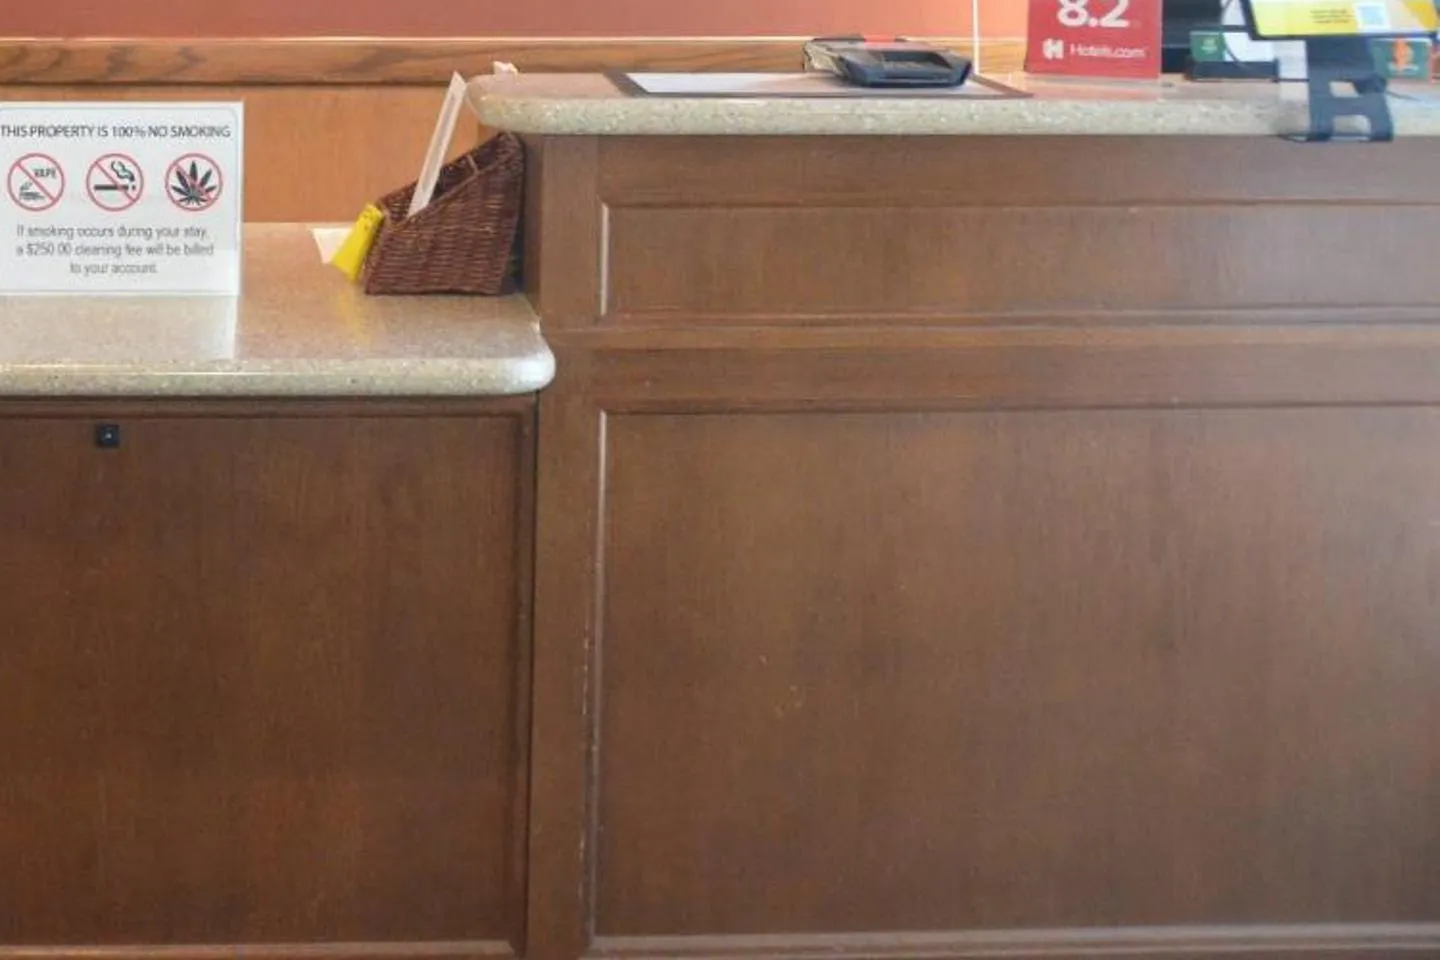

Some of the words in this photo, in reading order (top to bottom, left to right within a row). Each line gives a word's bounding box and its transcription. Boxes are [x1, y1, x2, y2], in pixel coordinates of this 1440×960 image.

[1070, 43, 1146, 58] Hotels.com
[0, 124, 27, 137] THIS
[29, 124, 94, 137] PROPERTY
[98, 125, 109, 137] IS
[112, 125, 146, 137] 100%
[147, 125, 168, 137] NO
[170, 125, 231, 138] SMOKING
[27, 225, 75, 240] smoking
[77, 227, 114, 238] occurs
[118, 225, 153, 240] during
[155, 227, 179, 240] your
[16, 246, 24, 256] a
[74, 243, 122, 259] cleaning
[125, 244, 143, 256] fee
[146, 243, 163, 256] will
[166, 243, 181, 256] be
[184, 243, 214, 256] billed
[70, 262, 82, 274] to
[83, 264, 108, 277] your
